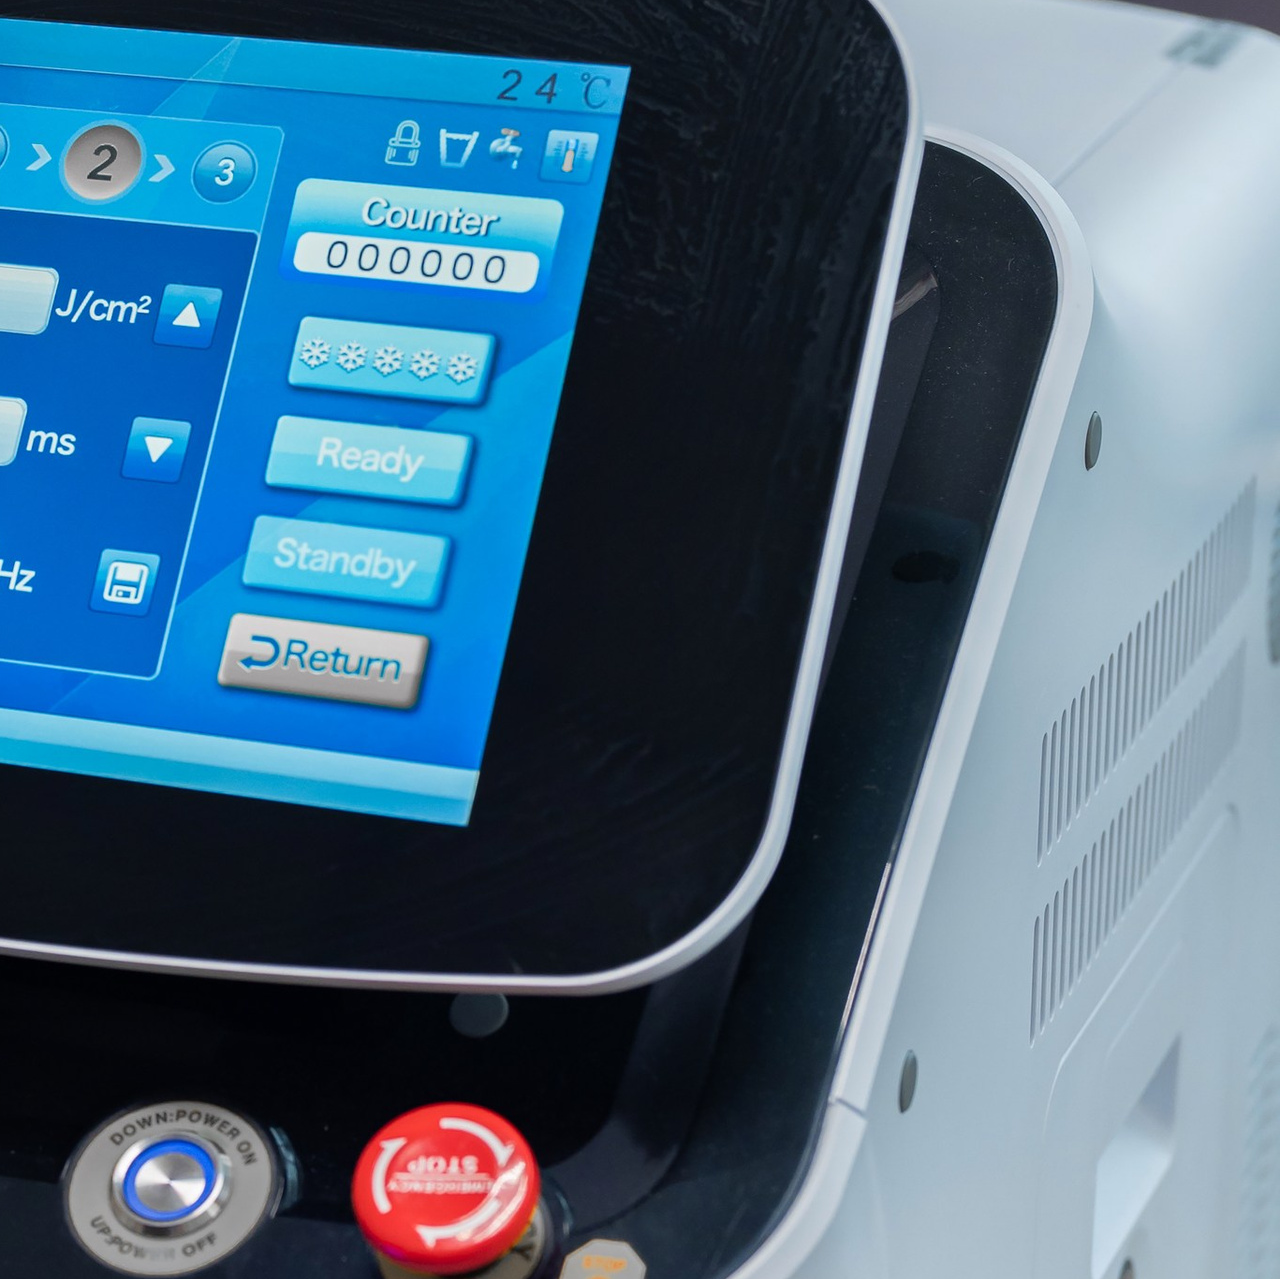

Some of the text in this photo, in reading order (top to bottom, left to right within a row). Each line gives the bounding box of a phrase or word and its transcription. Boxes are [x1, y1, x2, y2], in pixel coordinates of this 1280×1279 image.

[86, 144, 118, 181] 2
[214, 159, 235, 187] 3
[361, 196, 499, 237] Counter
[326, 241, 506, 284] 000000
[26, 429, 76, 455] ms
[317, 437, 424, 482] Ready
[273, 537, 417, 588] Standby
[283, 639, 402, 681] Return
[237, 1139, 259, 1166] ON
[407, 1155, 479, 1174] STOP
[181, 1232, 217, 1258] OFF
